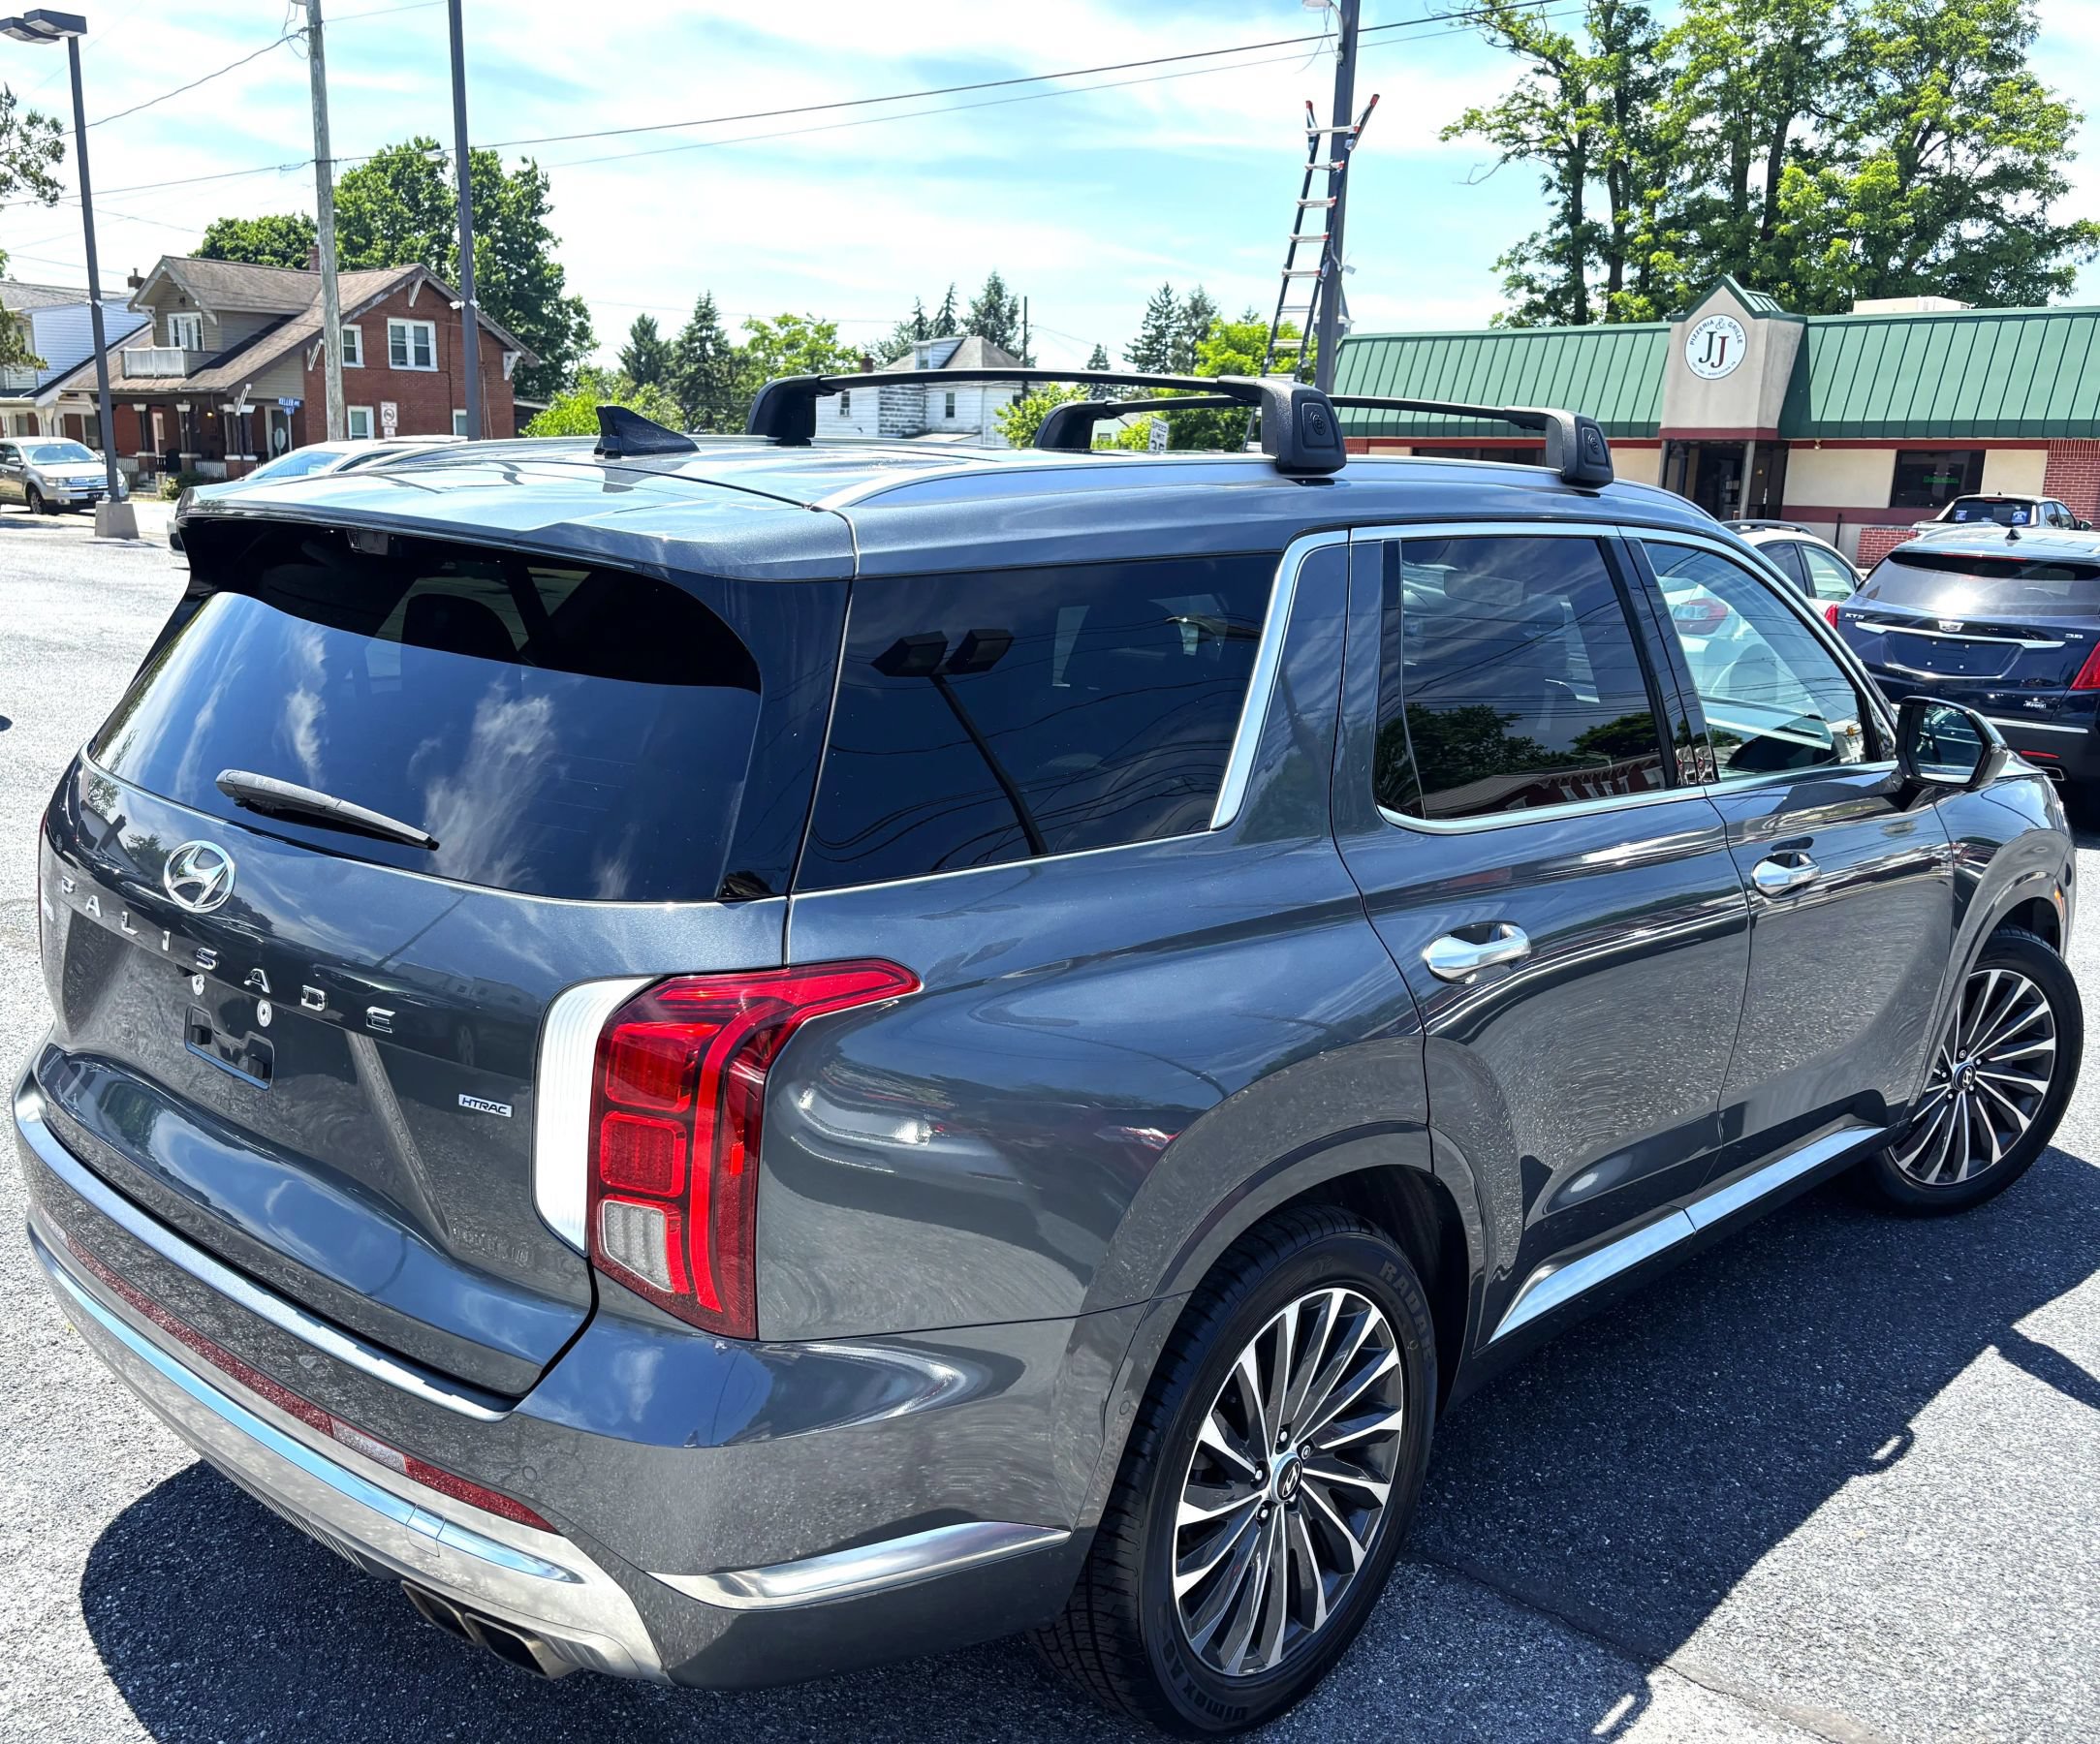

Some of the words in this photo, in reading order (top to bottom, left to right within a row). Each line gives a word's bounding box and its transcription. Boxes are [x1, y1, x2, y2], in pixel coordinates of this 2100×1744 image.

[1690, 319, 1714, 345] PIZZERIA
[1727, 322, 1742, 344] GRILLE
[61, 875, 395, 1034] PALISADE
[461, 1096, 508, 1115] HTRAC
